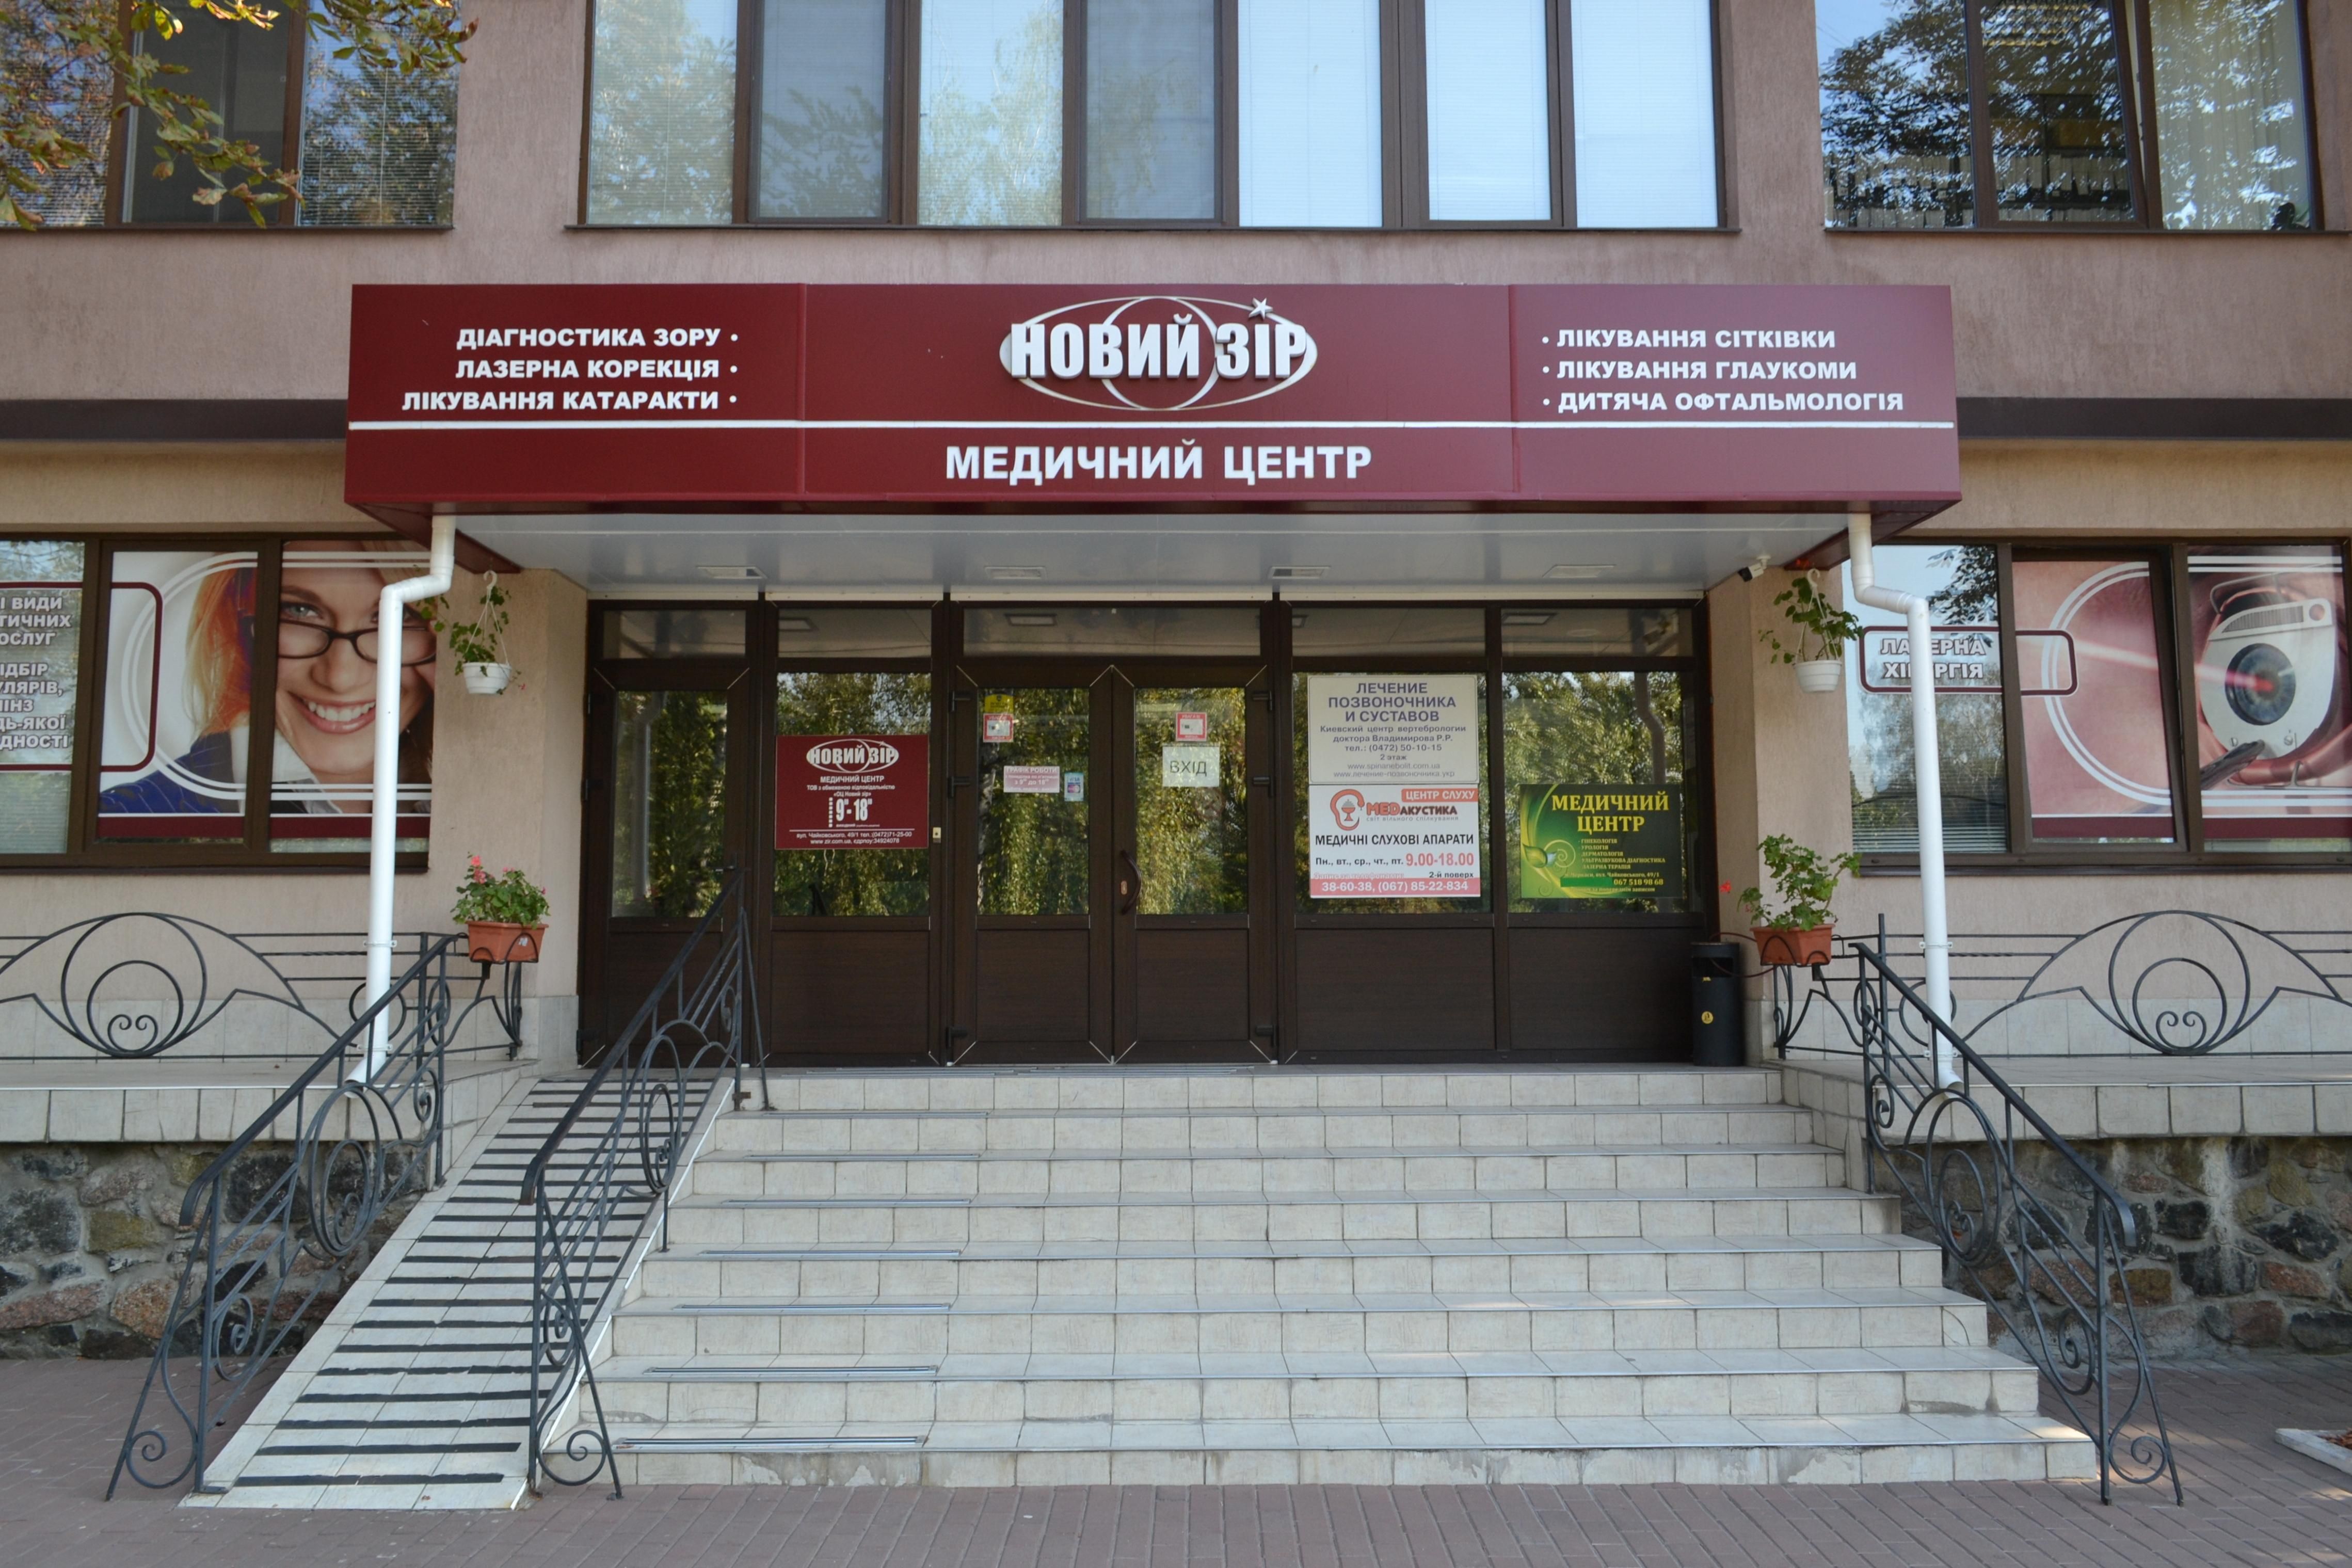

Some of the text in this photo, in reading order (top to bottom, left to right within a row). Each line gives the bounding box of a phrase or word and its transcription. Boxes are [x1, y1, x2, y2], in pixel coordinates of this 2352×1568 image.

[456, 328, 721, 350] ДІАГНОСТИКА ЗОРУ
[1011, 313, 1307, 379] НОВИЙ ЗІР
[1557, 329, 1835, 348] ЛІКУВАННЯ СІТКІВКИ
[455, 360, 719, 381] ЛАЗЕРНА КОРЕКЦІЯ
[1557, 361, 1857, 379] ЛІКУВАННЯ ГЛАУКОМИ
[402, 391, 718, 411] ЛІКУВАННЯ КАТАРАКТИ
[1558, 392, 1903, 414] ДИТЯЧА ОФТАЛЬМОЛОГІЯ
[946, 438, 1372, 486] МЕДИЧНИЙ ЦЕНТР
[12, 597, 62, 611] ВИДИ
[1881, 638, 1986, 655] ЛАЕРНА
[1884, 663, 1983, 678] ХІРГІЯ
[1356, 683, 1428, 694] ЛЕЧЕНИЕ
[1329, 697, 1456, 708] ПОЗВОНОЧНИКА
[1346, 711, 1439, 722] И СУСТАВОВ
[809, 745, 895, 764] НОВИЙ ЗІР
[1369, 744, 1398, 753] (0472)
[1170, 760, 1207, 776] ВХІД
[820, 775, 859, 783] МЕДИЧНИЙ
[1406, 791, 1475, 800] ЦЕНТР СЛУХУ
[1552, 791, 1669, 813] МЕДИЧНИЙ
[1577, 816, 1645, 835] ЦЕНТР
[1316, 834, 1474, 846] МЕДИЧНІ СЛУХОВІ АПАРАТИ
[1316, 857, 1333, 866] Пн.,
[1406, 853, 1474, 866] 9.00-18.00
[1322, 881, 1468, 892] 38-60-38, (067) 85-22-834
